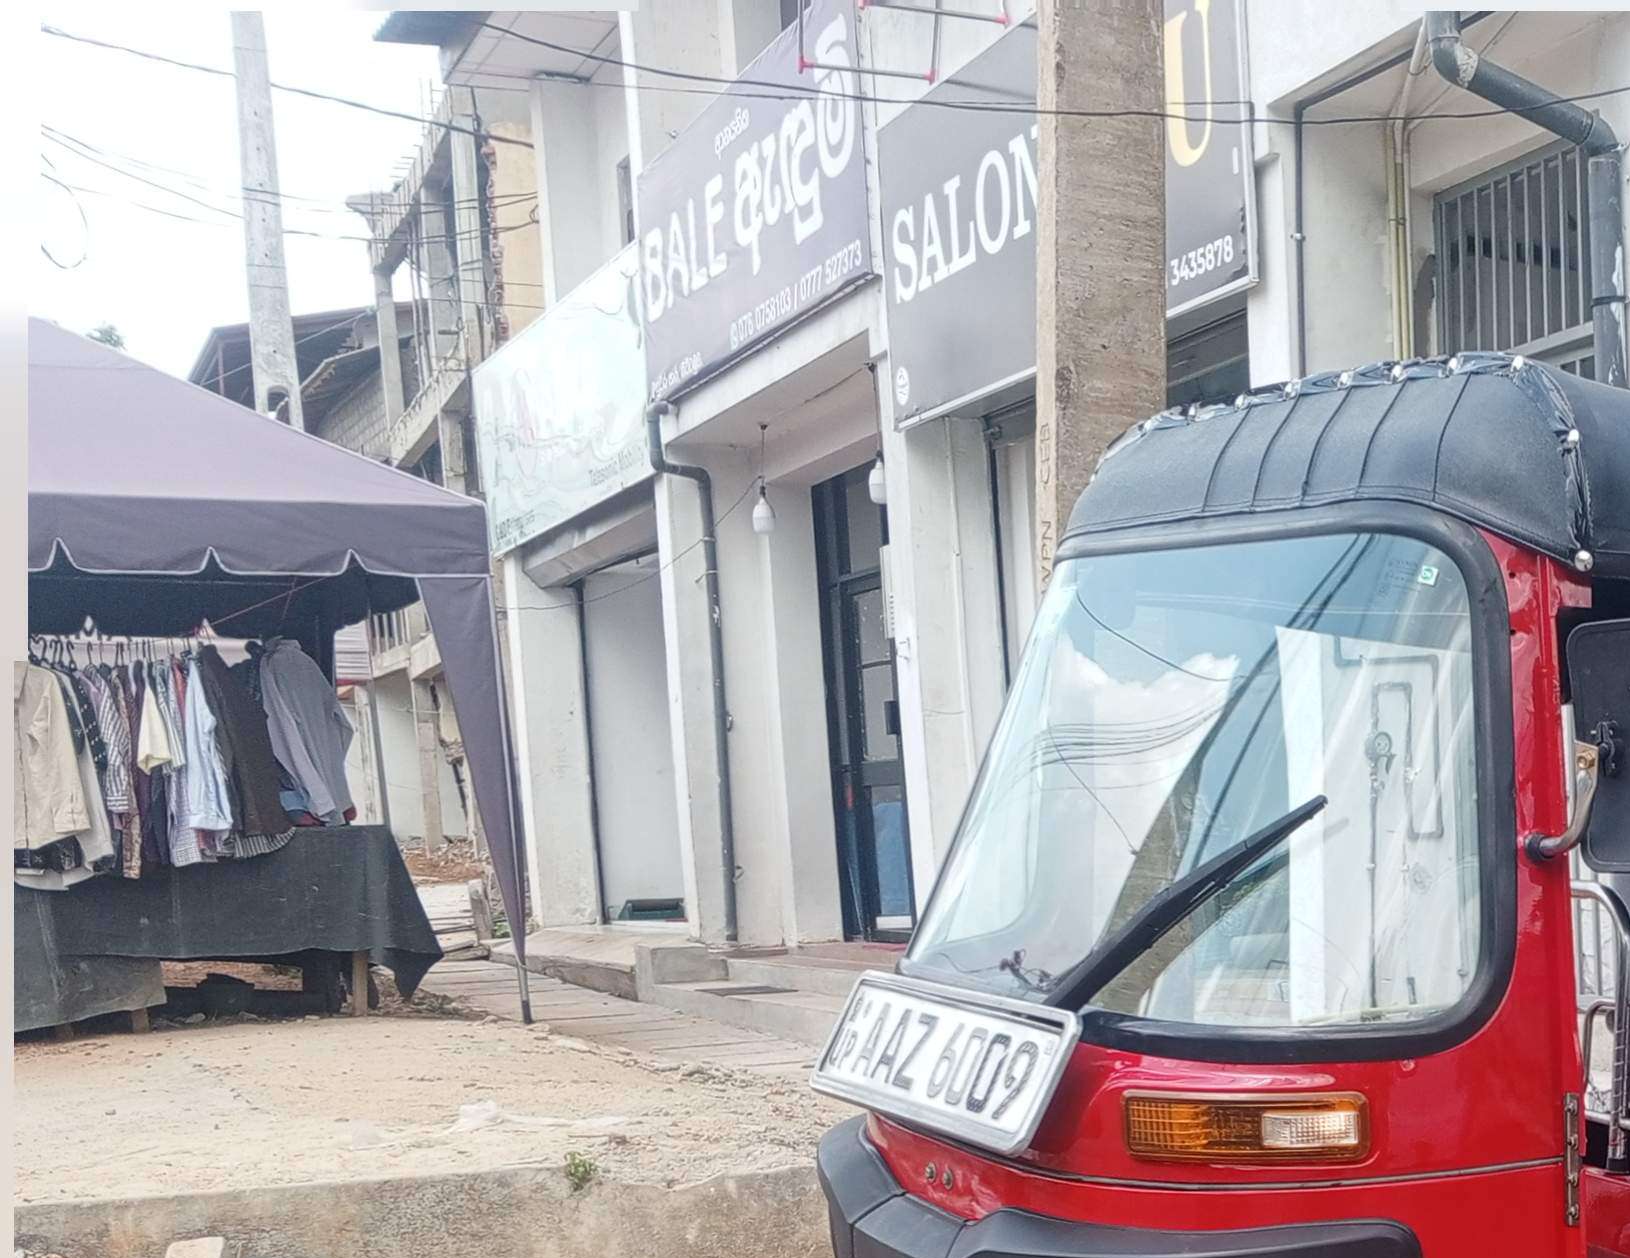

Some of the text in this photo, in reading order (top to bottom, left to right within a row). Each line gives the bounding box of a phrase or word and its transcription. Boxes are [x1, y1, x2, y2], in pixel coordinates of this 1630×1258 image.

[644, 173, 728, 323] BALE
[800, 264, 823, 301] 0777
[824, 239, 862, 285] 527373
[850, 1001, 1039, 1121] AAZ 6009
